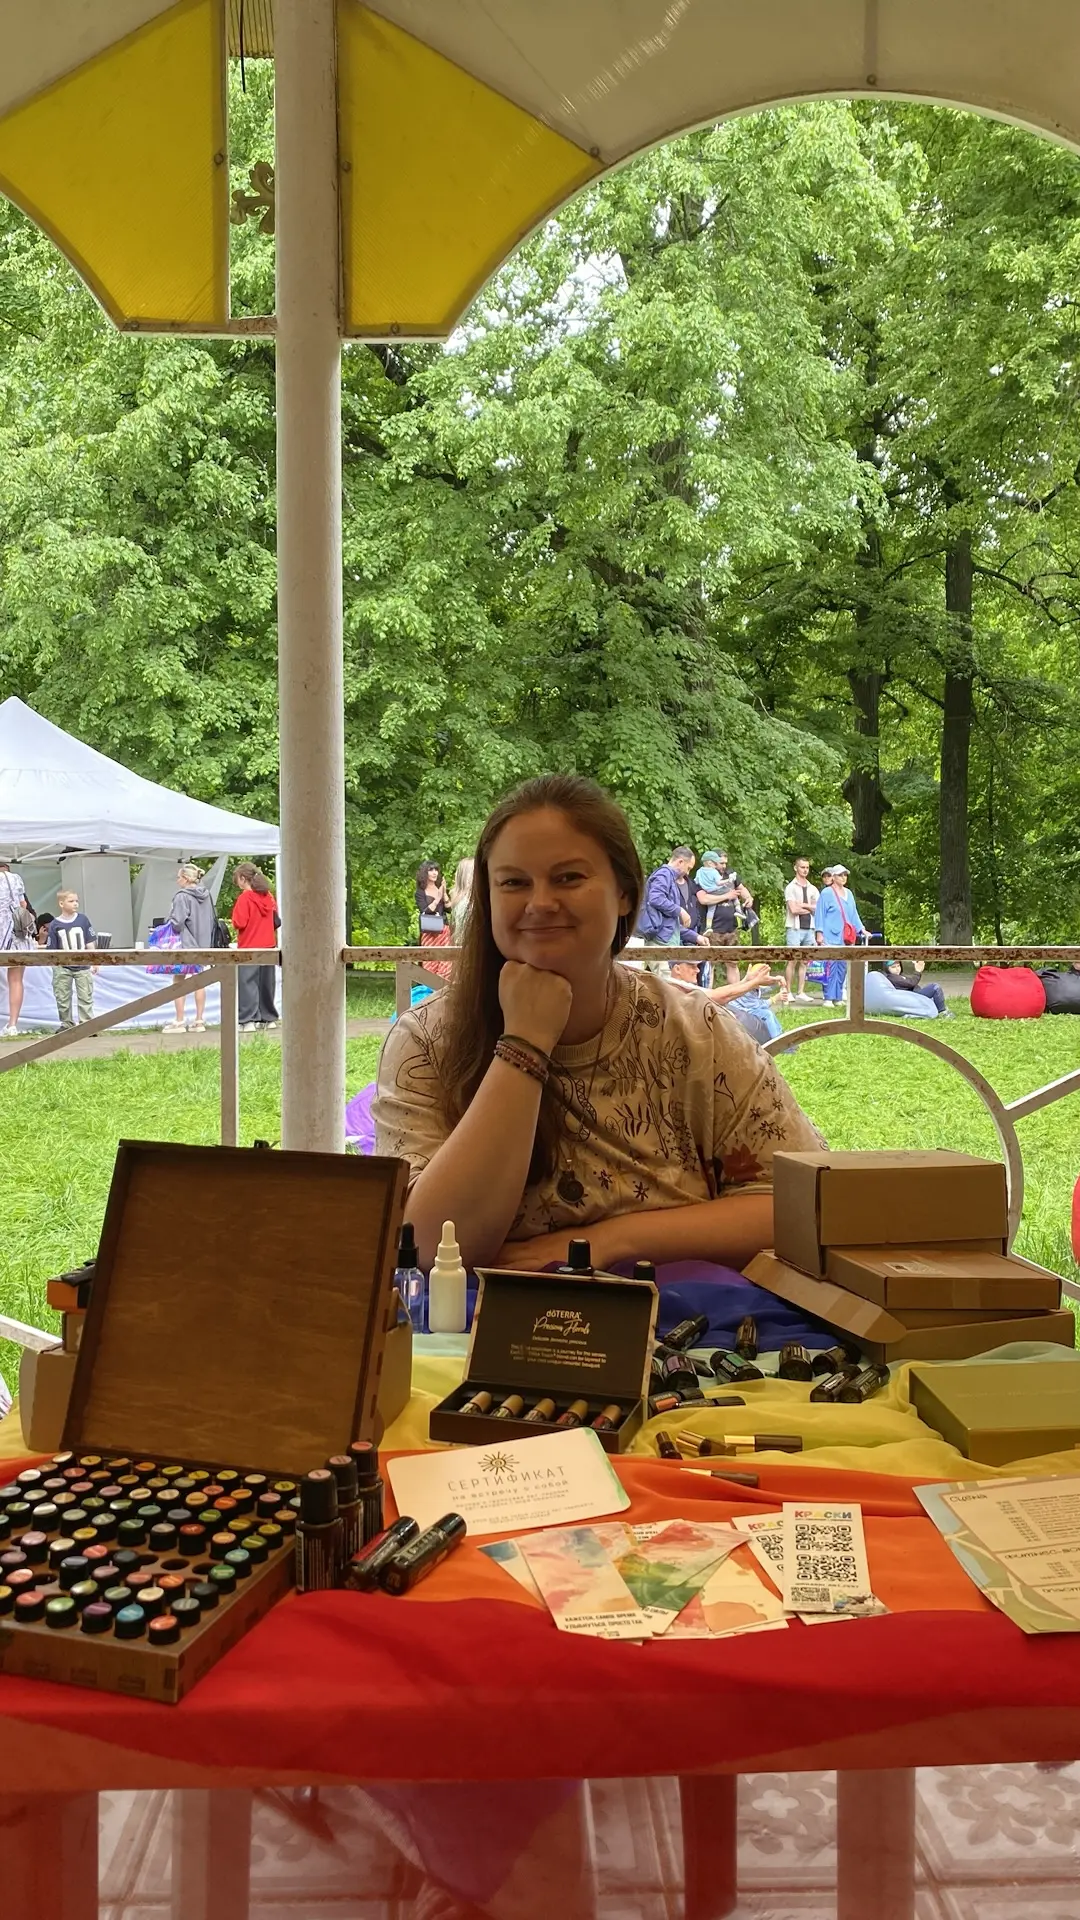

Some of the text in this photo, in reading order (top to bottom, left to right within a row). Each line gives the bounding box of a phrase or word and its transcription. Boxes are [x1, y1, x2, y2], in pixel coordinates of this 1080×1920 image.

[57, 926, 85, 950] 10
[448, 1466, 565, 1492] СЕРТИФИКАТ
[794, 1510, 852, 1519] КРАСКИ
[747, 1520, 783, 1531] КРАС
